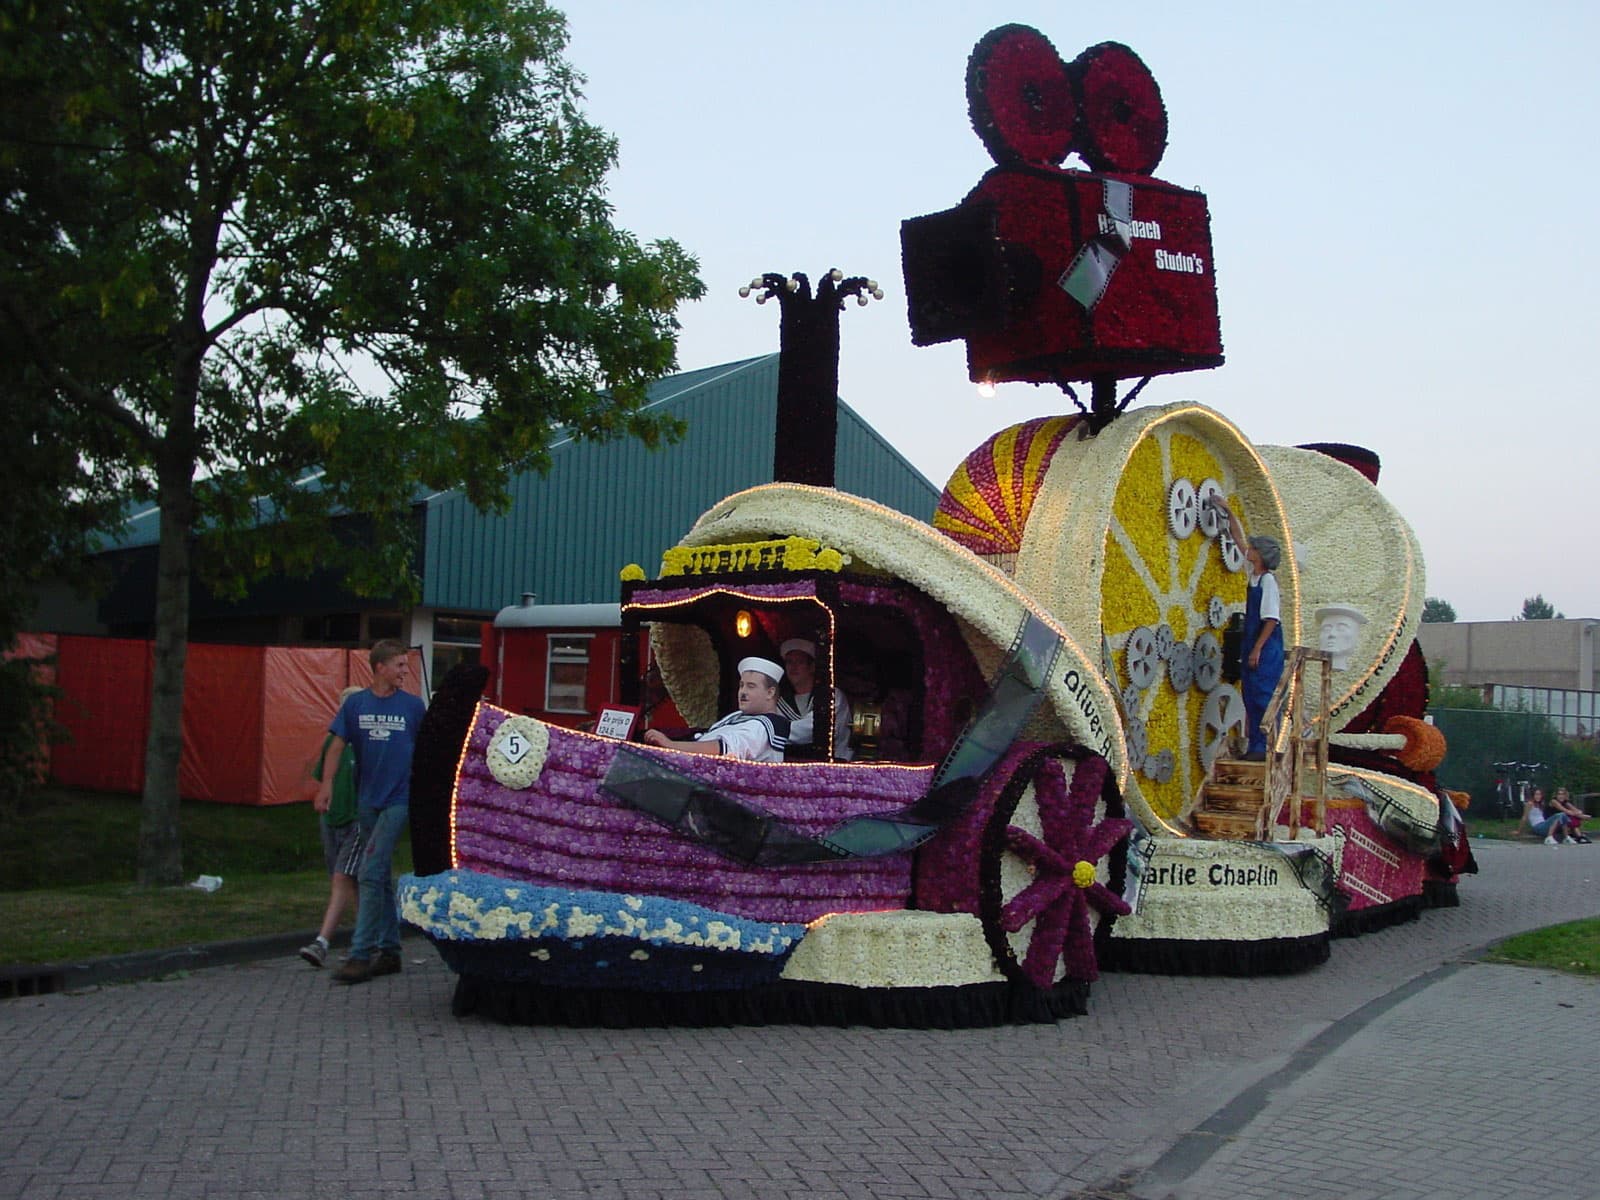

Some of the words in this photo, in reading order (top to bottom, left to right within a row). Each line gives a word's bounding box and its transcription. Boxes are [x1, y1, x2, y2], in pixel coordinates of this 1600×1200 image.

[1130, 220, 1161, 240] oach
[1155, 249, 1203, 274] Studio's
[1063, 670, 1104, 738] Oliver
[1329, 679, 1370, 717] uster
[509, 736, 521, 754] 5
[1147, 863, 1197, 886] arlie
[1208, 863, 1278, 886] Chaplin
